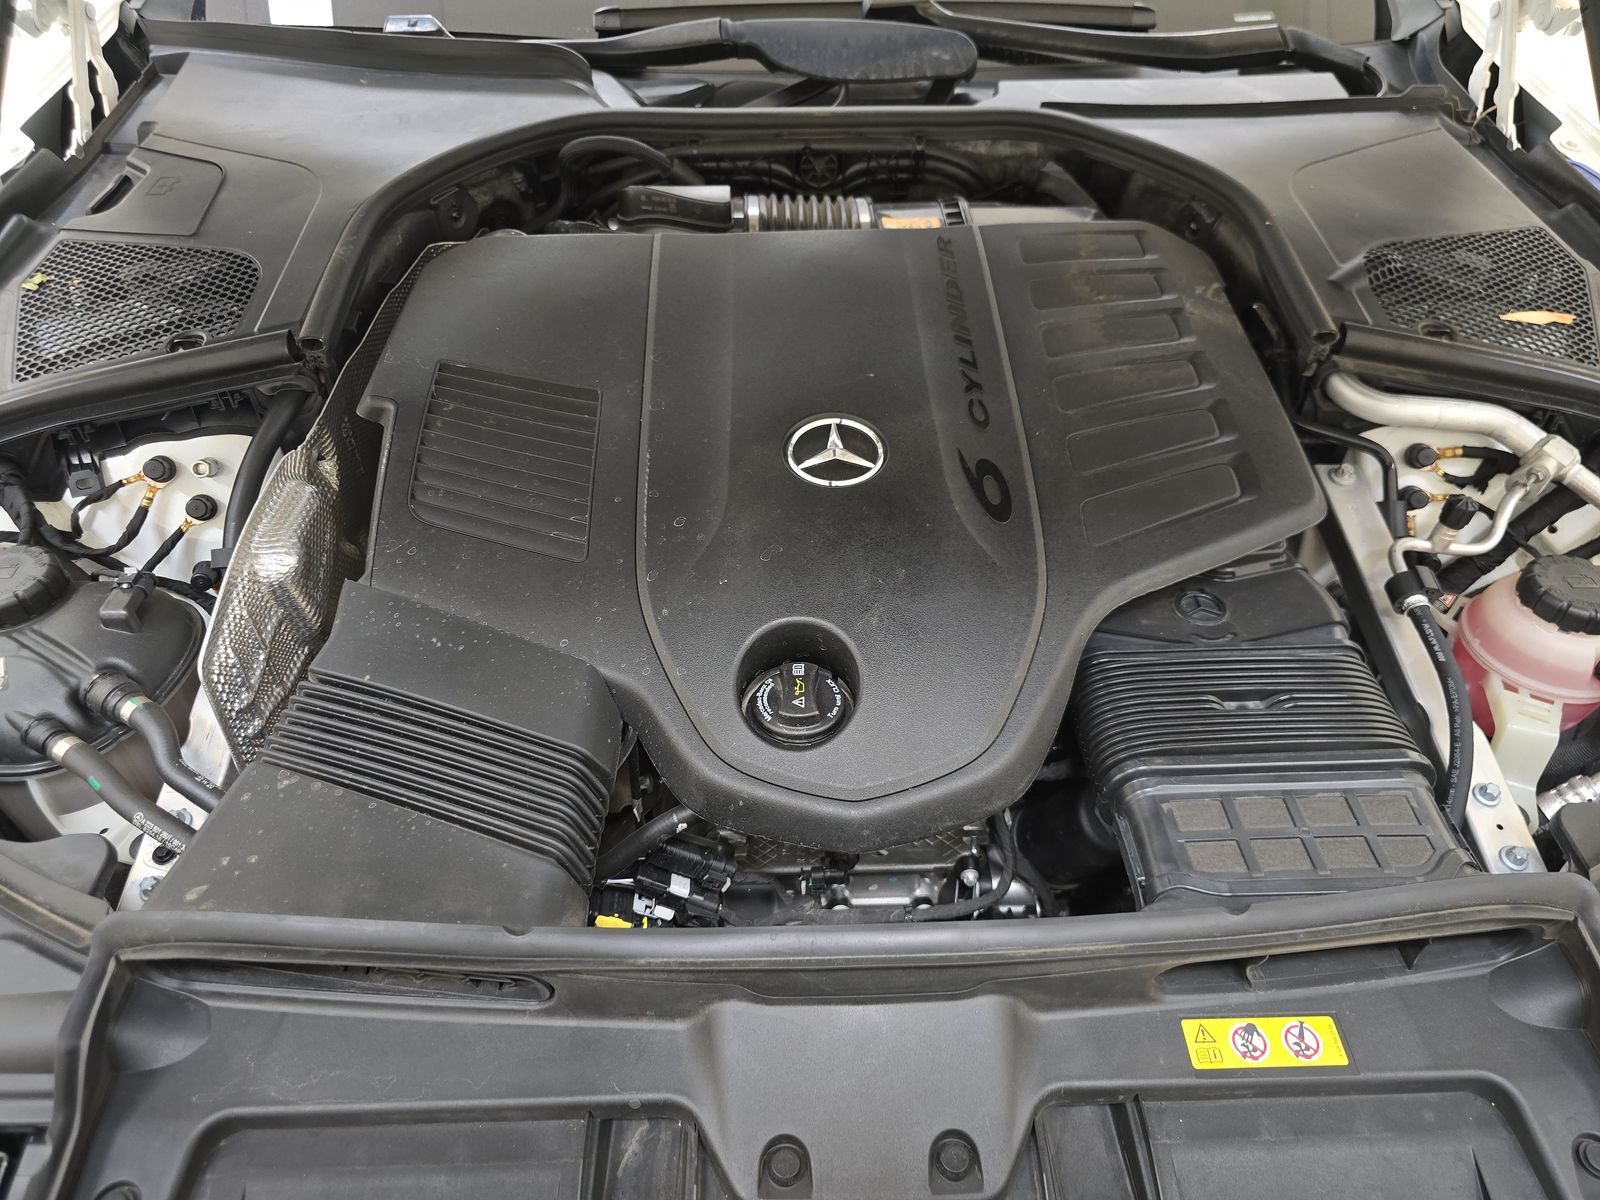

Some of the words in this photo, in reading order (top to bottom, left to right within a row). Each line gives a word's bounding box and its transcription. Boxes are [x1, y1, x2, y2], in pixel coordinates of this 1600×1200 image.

[936, 235, 990, 431] CYLINDER
[957, 447, 1012, 524] 6
[756, 684, 772, 722] Mercedes-Benz
[825, 678, 840, 693] CLICK
[827, 706, 839, 719] Turn
